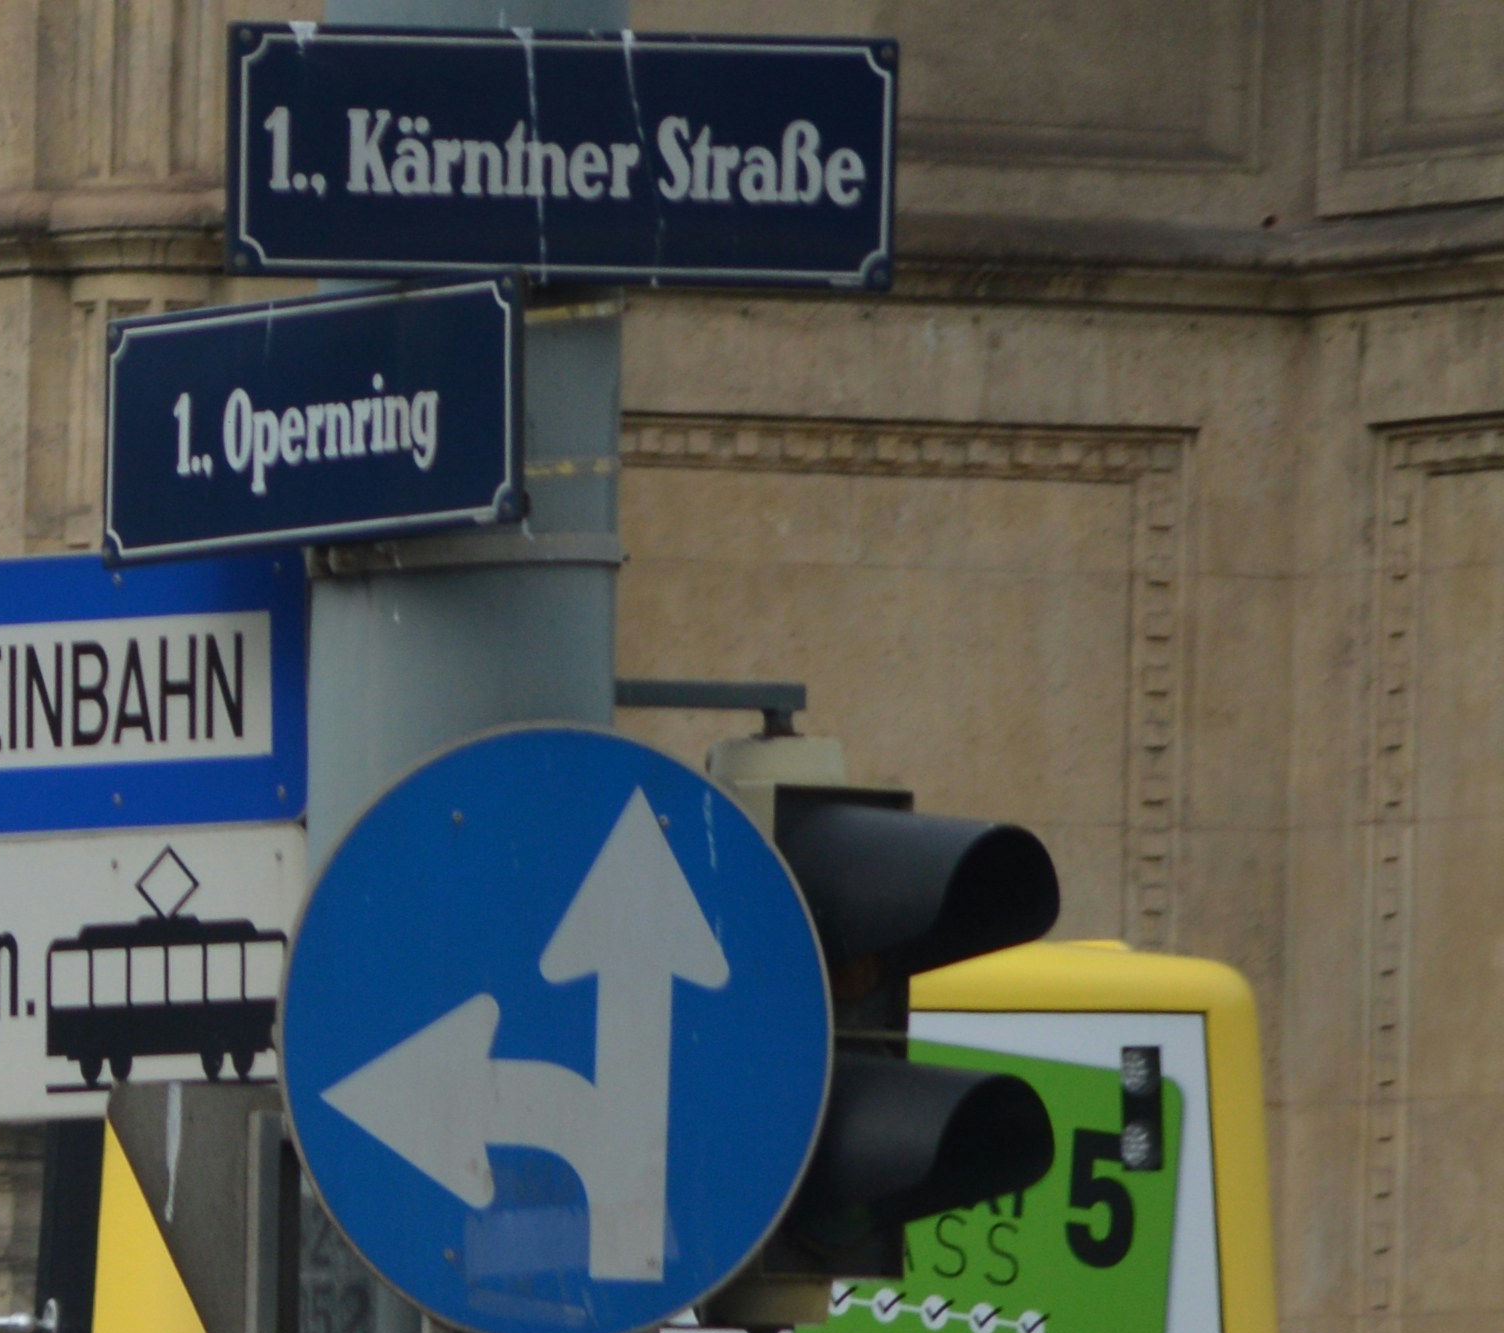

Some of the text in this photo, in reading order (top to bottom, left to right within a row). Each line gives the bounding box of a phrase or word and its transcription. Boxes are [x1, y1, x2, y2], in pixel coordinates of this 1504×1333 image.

[346, 108, 641, 199] Kärntner
[657, 115, 867, 206] Straße
[221, 373, 438, 495] Opernring
[1064, 1127, 1135, 1269] 5
